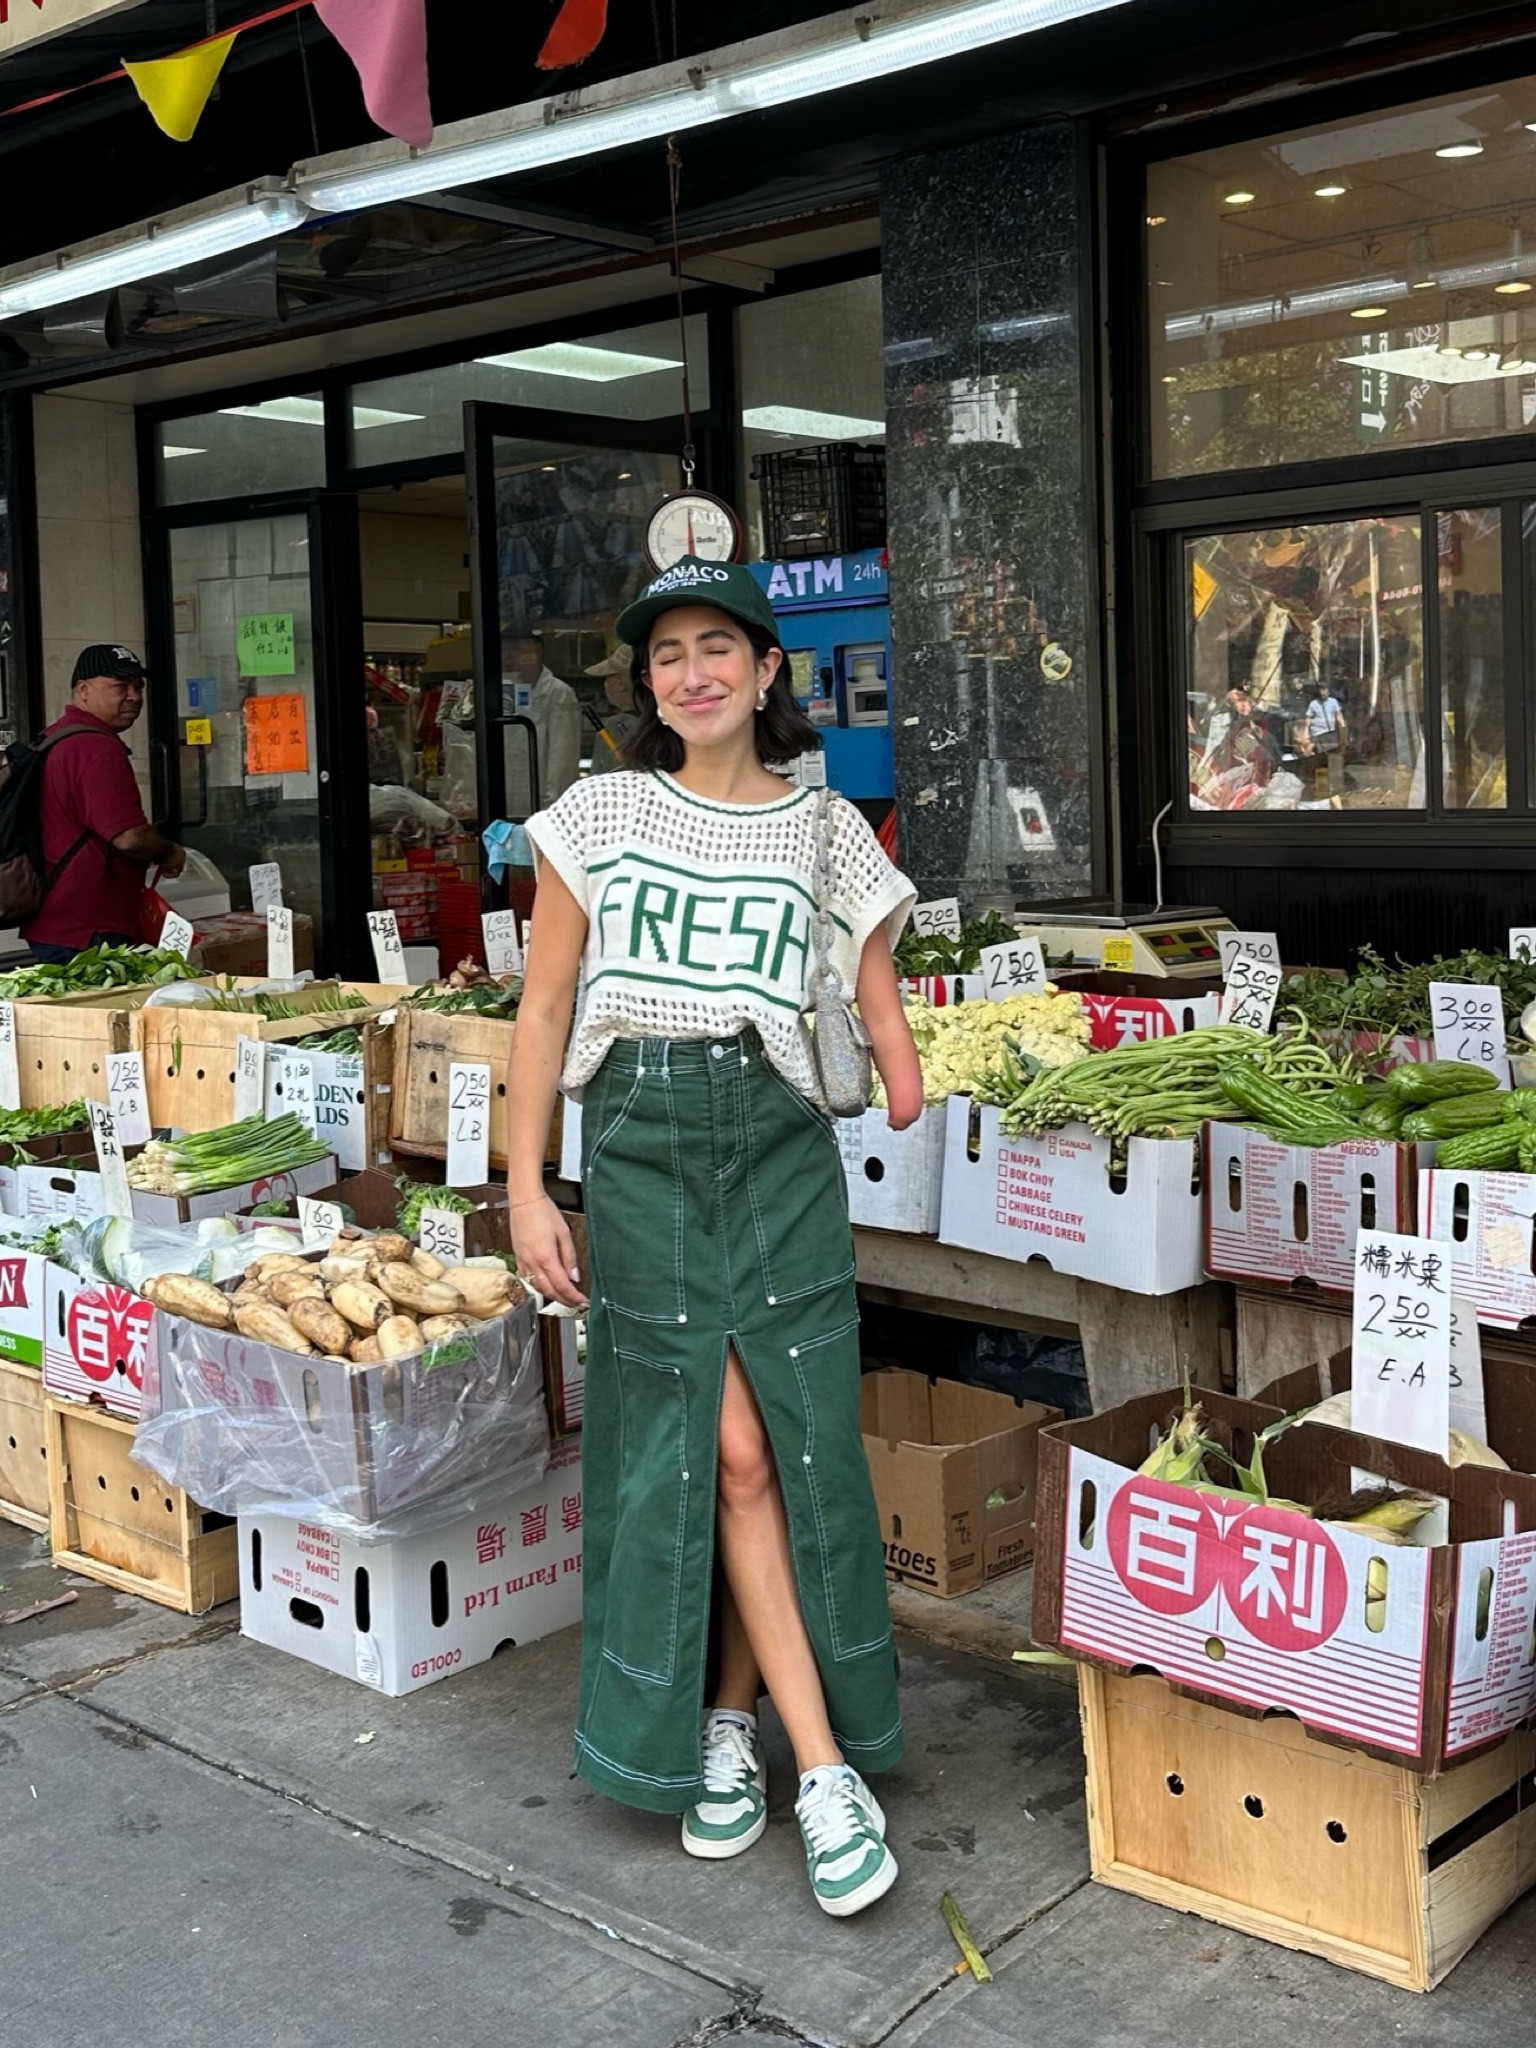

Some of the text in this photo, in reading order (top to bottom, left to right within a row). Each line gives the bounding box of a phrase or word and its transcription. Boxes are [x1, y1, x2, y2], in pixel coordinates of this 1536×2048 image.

[646, 564, 729, 598] MONACO
[767, 558, 881, 599] ATM 24h
[600, 876, 810, 989] FRESH
[1059, 1138, 1093, 1151] CANADA
[1060, 1149, 1076, 1159] USA
[1341, 1144, 1379, 1157] MEXICO
[1010, 1152, 1041, 1169] NAPPA
[1010, 1168, 1055, 1188] BOK CHOY
[1009, 1184, 1053, 1203] CABBAGE
[1008, 1200, 1084, 1227] CHINESE CELERY
[1008, 1216, 1086, 1244] MUSTARD GREEN
[298, 1523, 331, 1544] CABBAGE
[296, 1539, 331, 1560] BOK CHOY
[998, 1538, 1024, 1559] Fresh
[305, 1559, 330, 1578] NAPPA
[1126, 1491, 1327, 1634] 百利
[506, 1562, 557, 1596] Farm
[464, 1585, 499, 1618] Ltd
[411, 1648, 462, 1679] COOLED
